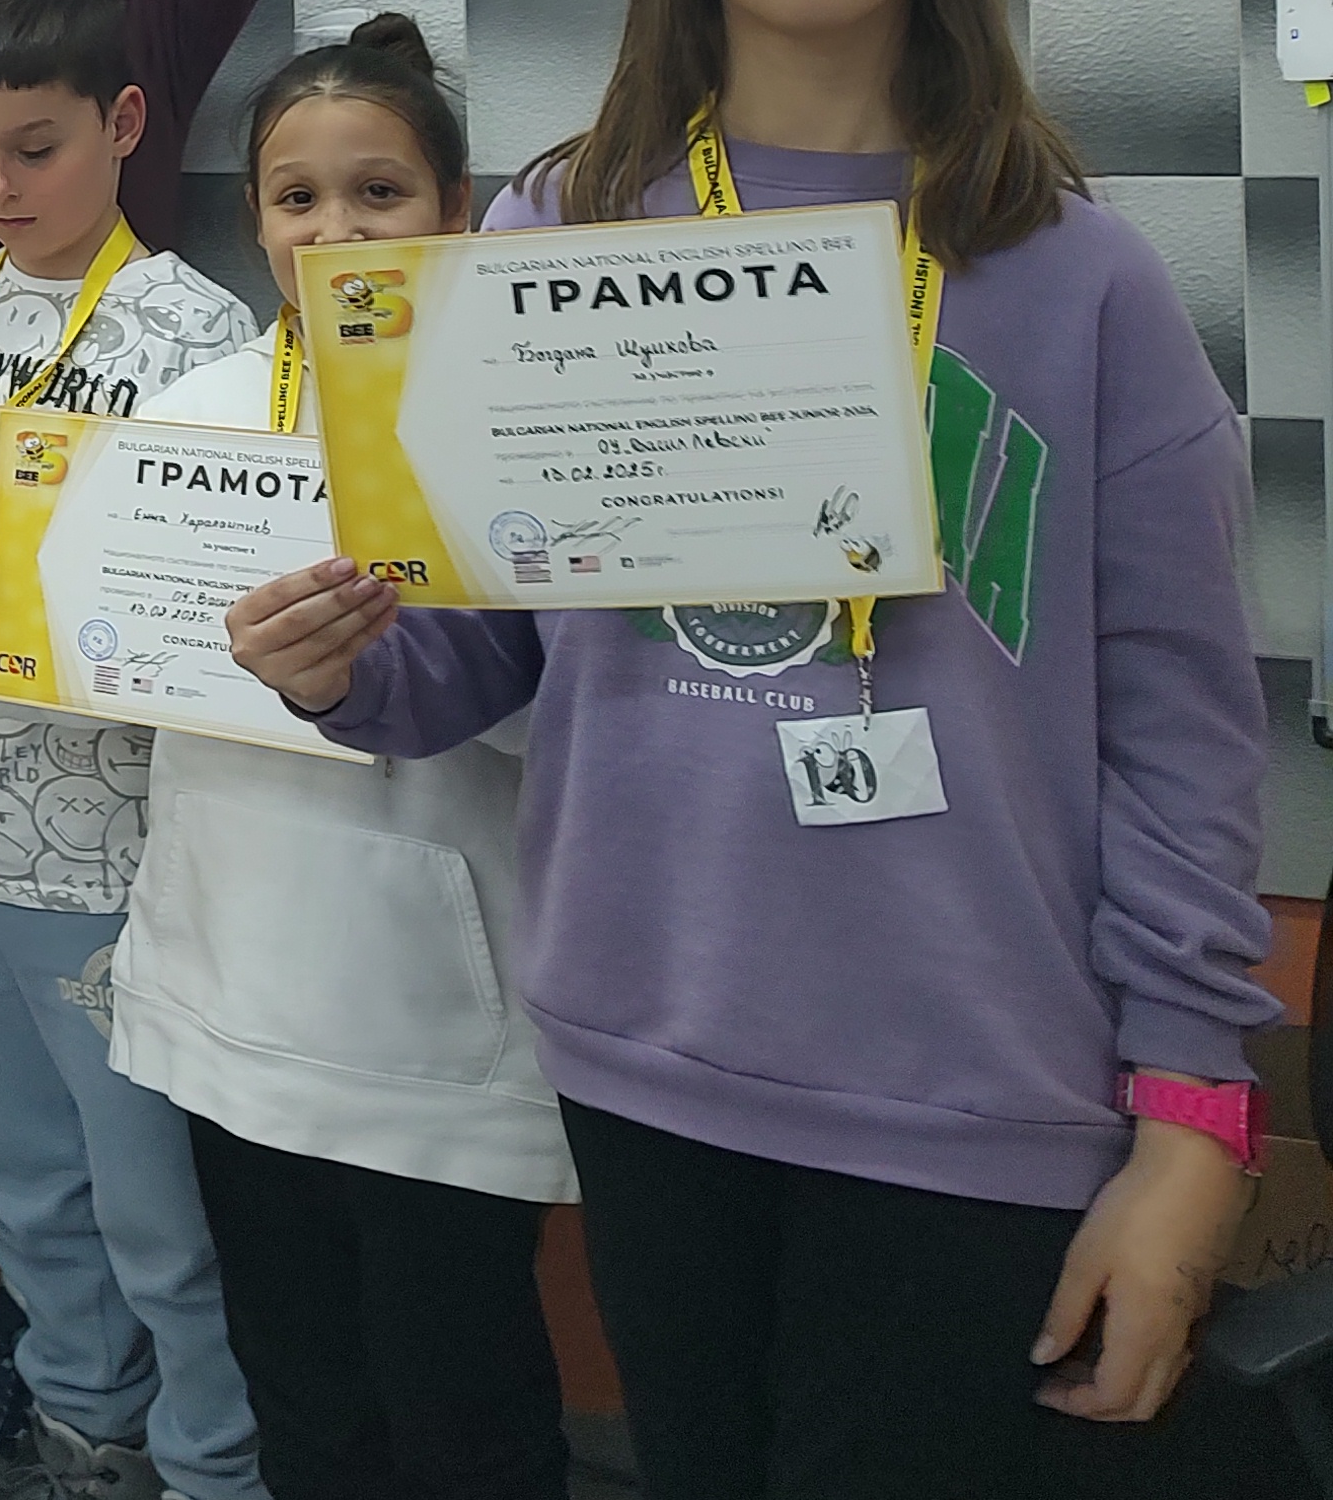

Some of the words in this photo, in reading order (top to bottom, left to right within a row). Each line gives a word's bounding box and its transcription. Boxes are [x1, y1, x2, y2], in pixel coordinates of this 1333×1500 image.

[702, 146, 731, 215] BULGARIA
[475, 256, 569, 278] BULGARIAN
[572, 249, 657, 272] NATIONAL
[659, 244, 733, 266] ENGLISH
[734, 238, 818, 261] SPELLING
[820, 235, 855, 254] BEE
[510, 260, 830, 316] ГРАМОТА
[910, 258, 930, 320] ENGLISH
[337, 322, 376, 340] BEE
[117, 440, 180, 458] BULGARIAN
[180, 445, 235, 463] NATIONAL
[235, 450, 283, 467] ENGLISH
[14, 468, 40, 483] BEE
[600, 486, 786, 511] CONGRATULATIONS!
[367, 560, 430, 586] COR
[161, 633, 234, 655] CONGRATU
[687, 616, 804, 659] TOURNAMENT
[667, 678, 757, 705] BASEBALL
[765, 690, 816, 714] CLUB
[793, 746, 879, 808] 10
